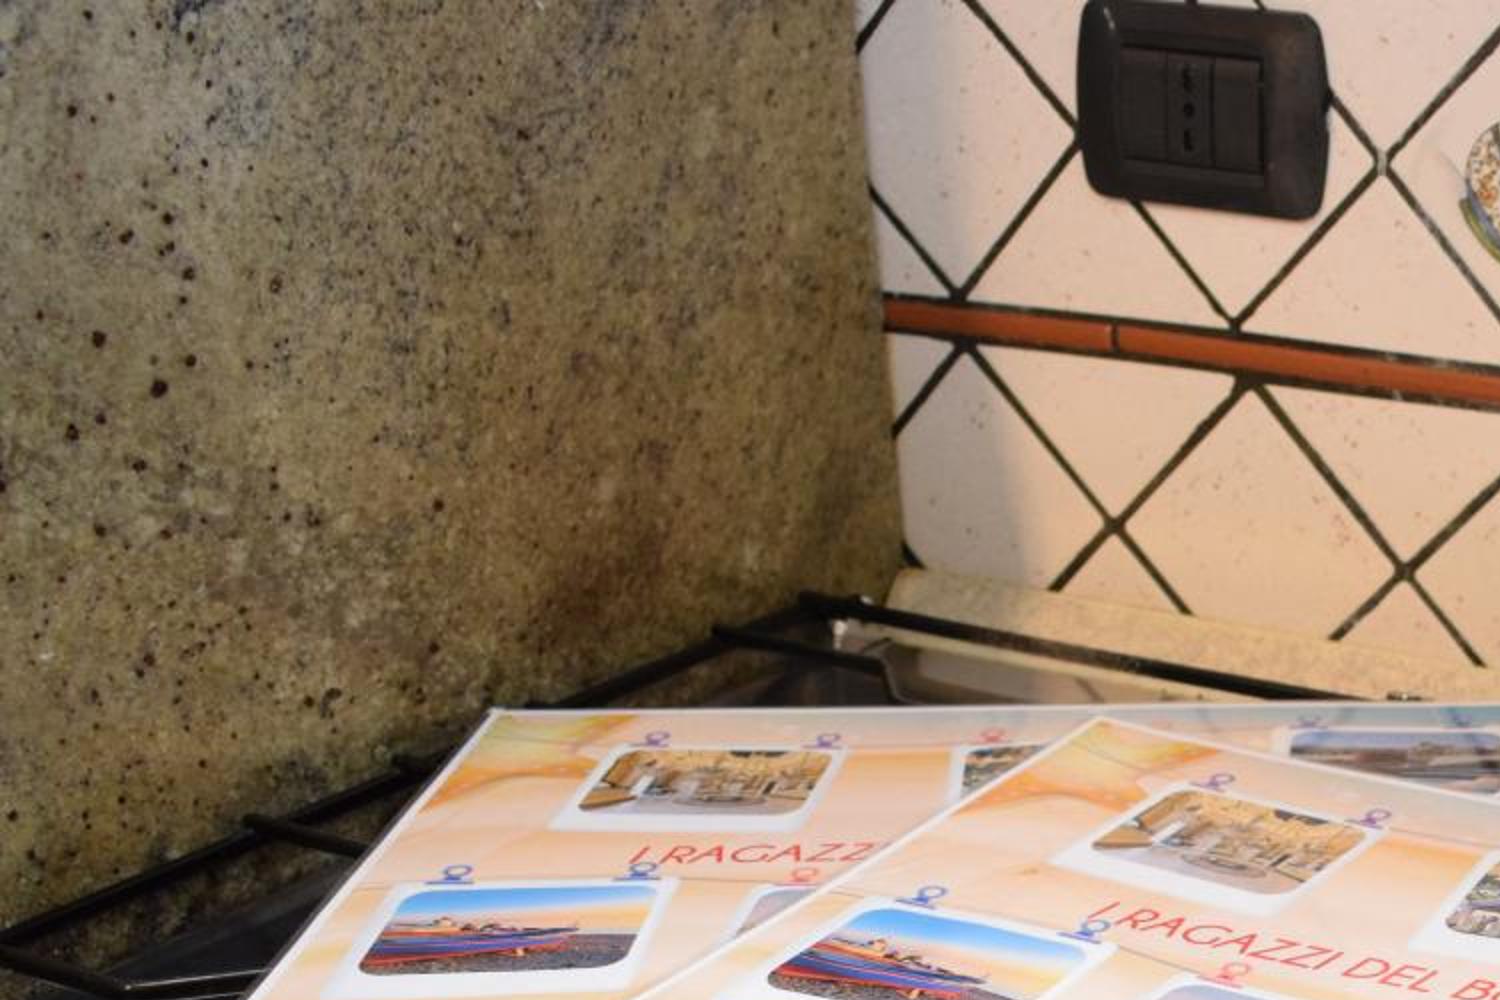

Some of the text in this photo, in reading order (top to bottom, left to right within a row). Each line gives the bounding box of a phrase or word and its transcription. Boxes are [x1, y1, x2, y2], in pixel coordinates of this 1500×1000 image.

[628, 842, 876, 866] I RAGAZZ
[1086, 900, 1121, 923] I
[1114, 908, 1345, 971] RAGAZZI
[1341, 956, 1439, 993] DEL
